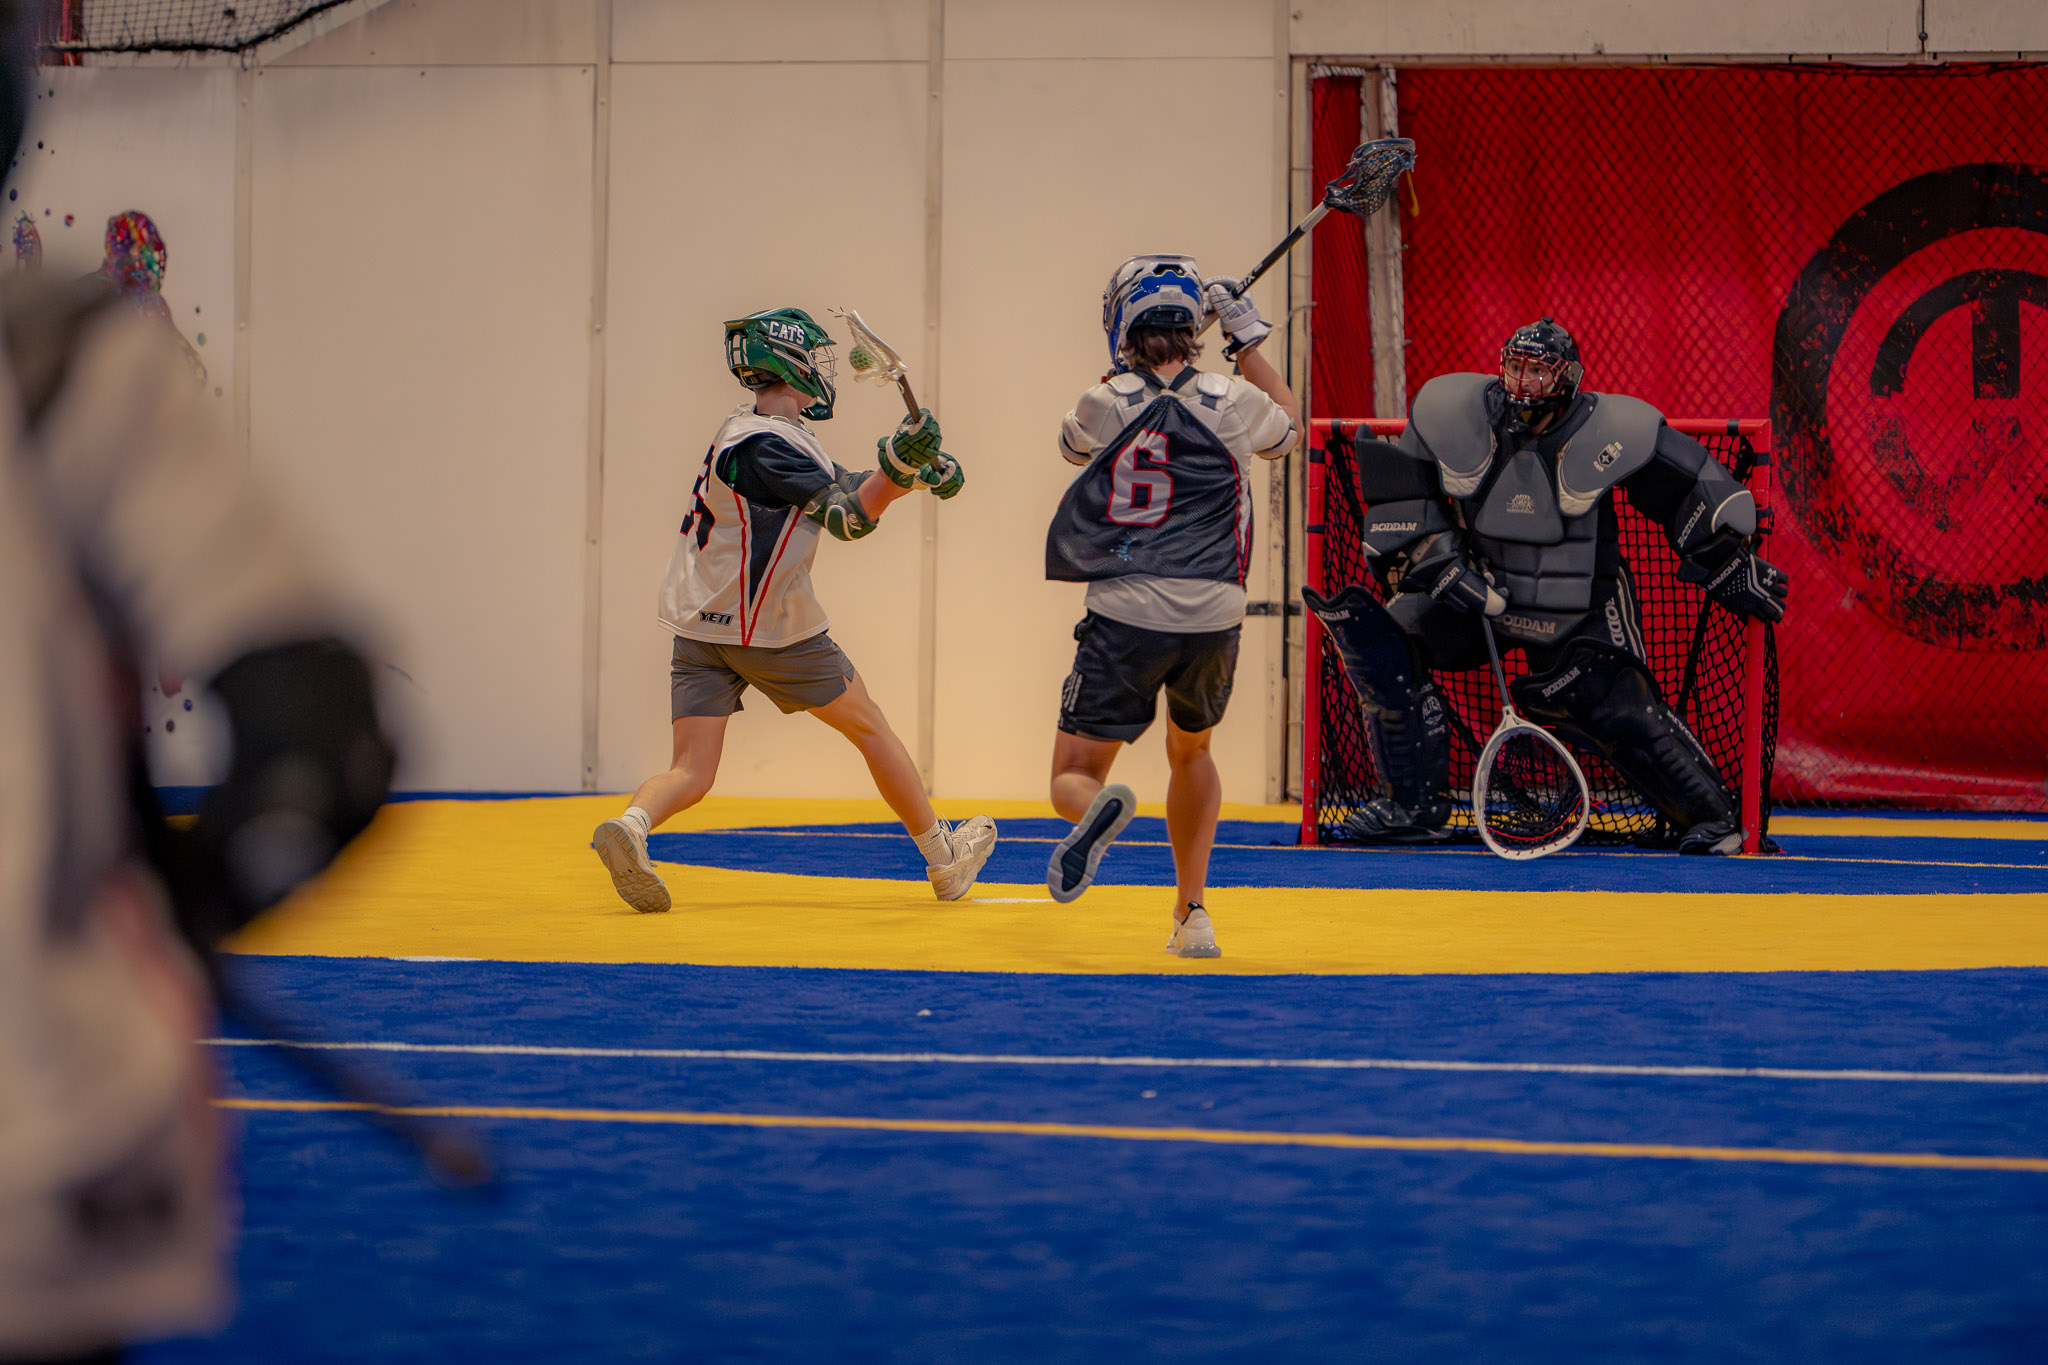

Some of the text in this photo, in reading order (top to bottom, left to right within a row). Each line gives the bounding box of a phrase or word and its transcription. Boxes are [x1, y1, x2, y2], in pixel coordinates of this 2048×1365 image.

[769, 321, 805, 345] CATS
[1106, 427, 1175, 527] 6
[1370, 522, 1417, 533] BODDAM
[1707, 557, 1742, 590] ARMOUR
[699, 611, 734, 626] YETI
[1499, 614, 1556, 634] ODDAM
